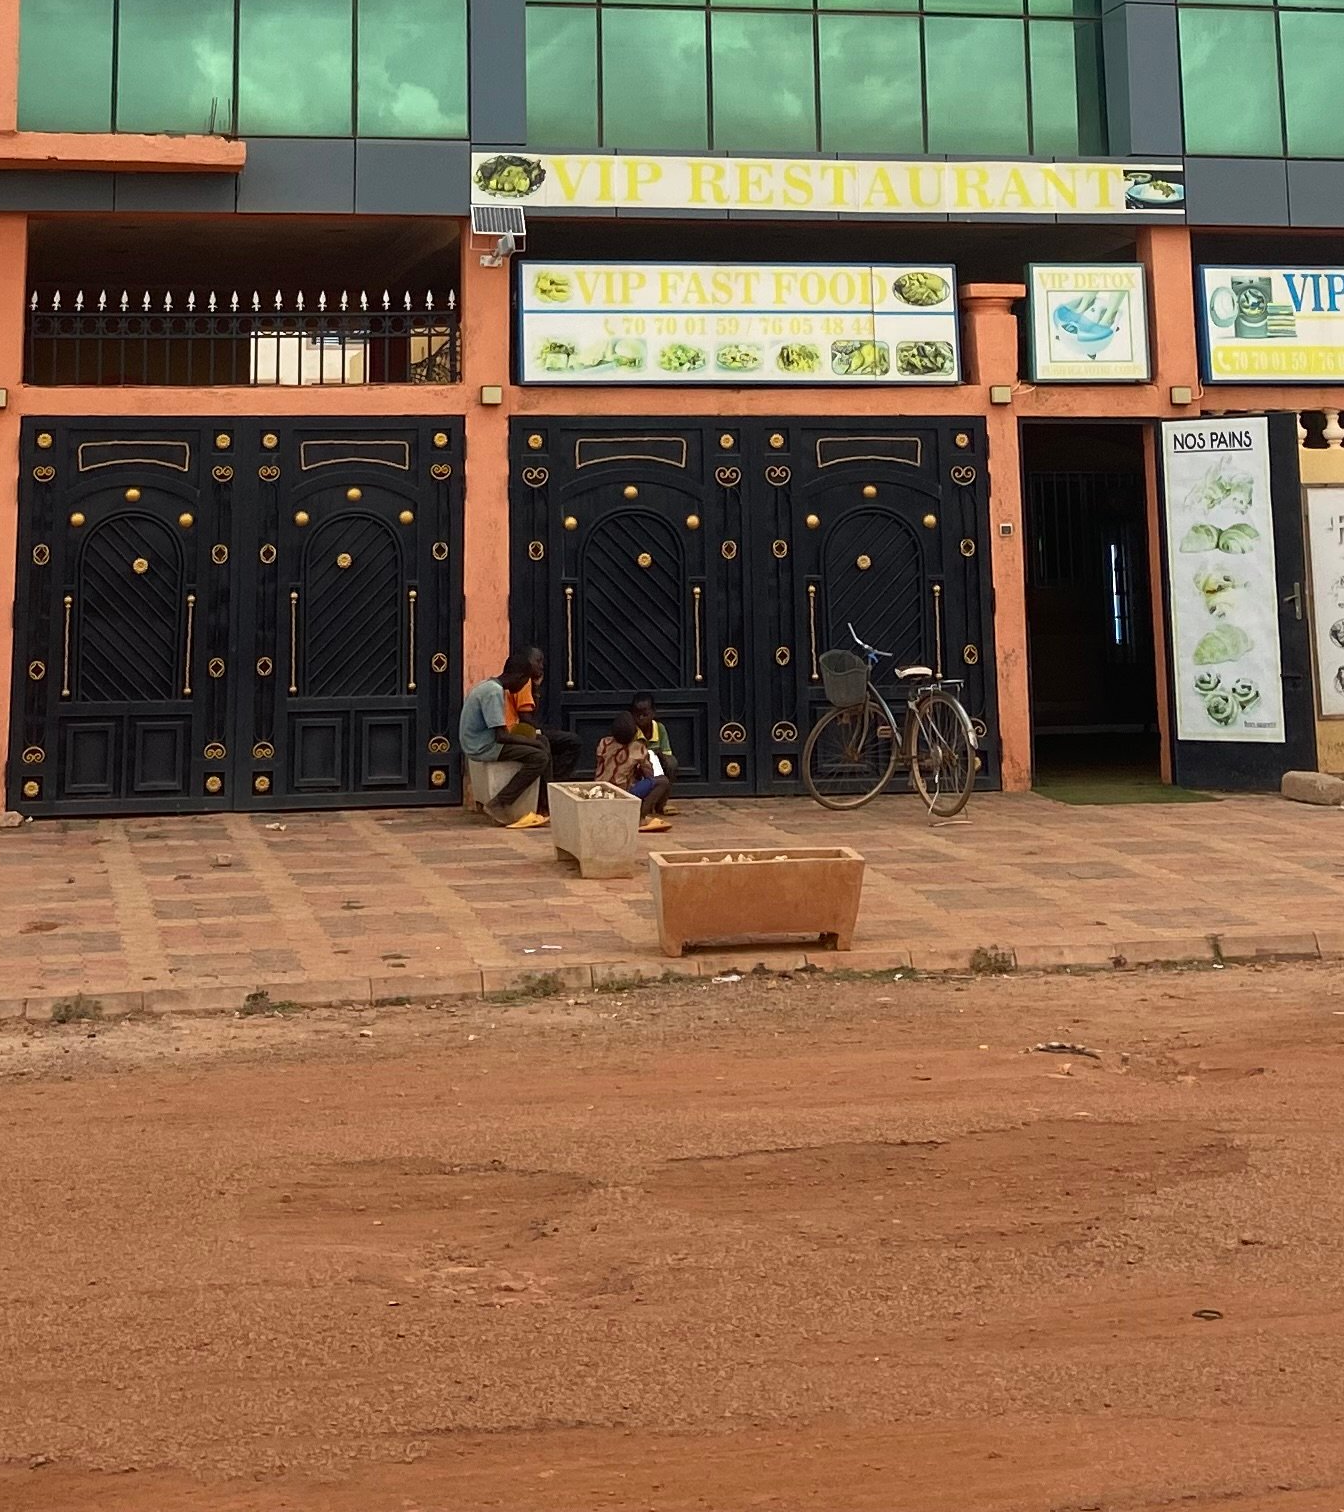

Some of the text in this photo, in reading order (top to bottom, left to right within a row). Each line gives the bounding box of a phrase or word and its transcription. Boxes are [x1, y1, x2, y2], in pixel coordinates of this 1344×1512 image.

[548, 156, 1125, 211] VIP RESTAURANT
[575, 270, 888, 307] VIP FAST FOOD
[1038, 272, 1136, 289] VIP DETOX
[623, 317, 645, 337] 70
[654, 317, 677, 337] 70
[684, 317, 707, 337] 01
[715, 317, 740, 337] 59
[760, 317, 783, 337] 76
[790, 317, 813, 337] 05
[822, 317, 844, 337] 48
[851, 317, 873, 337] 44
[1173, 431, 1252, 450] NOS PAINS
